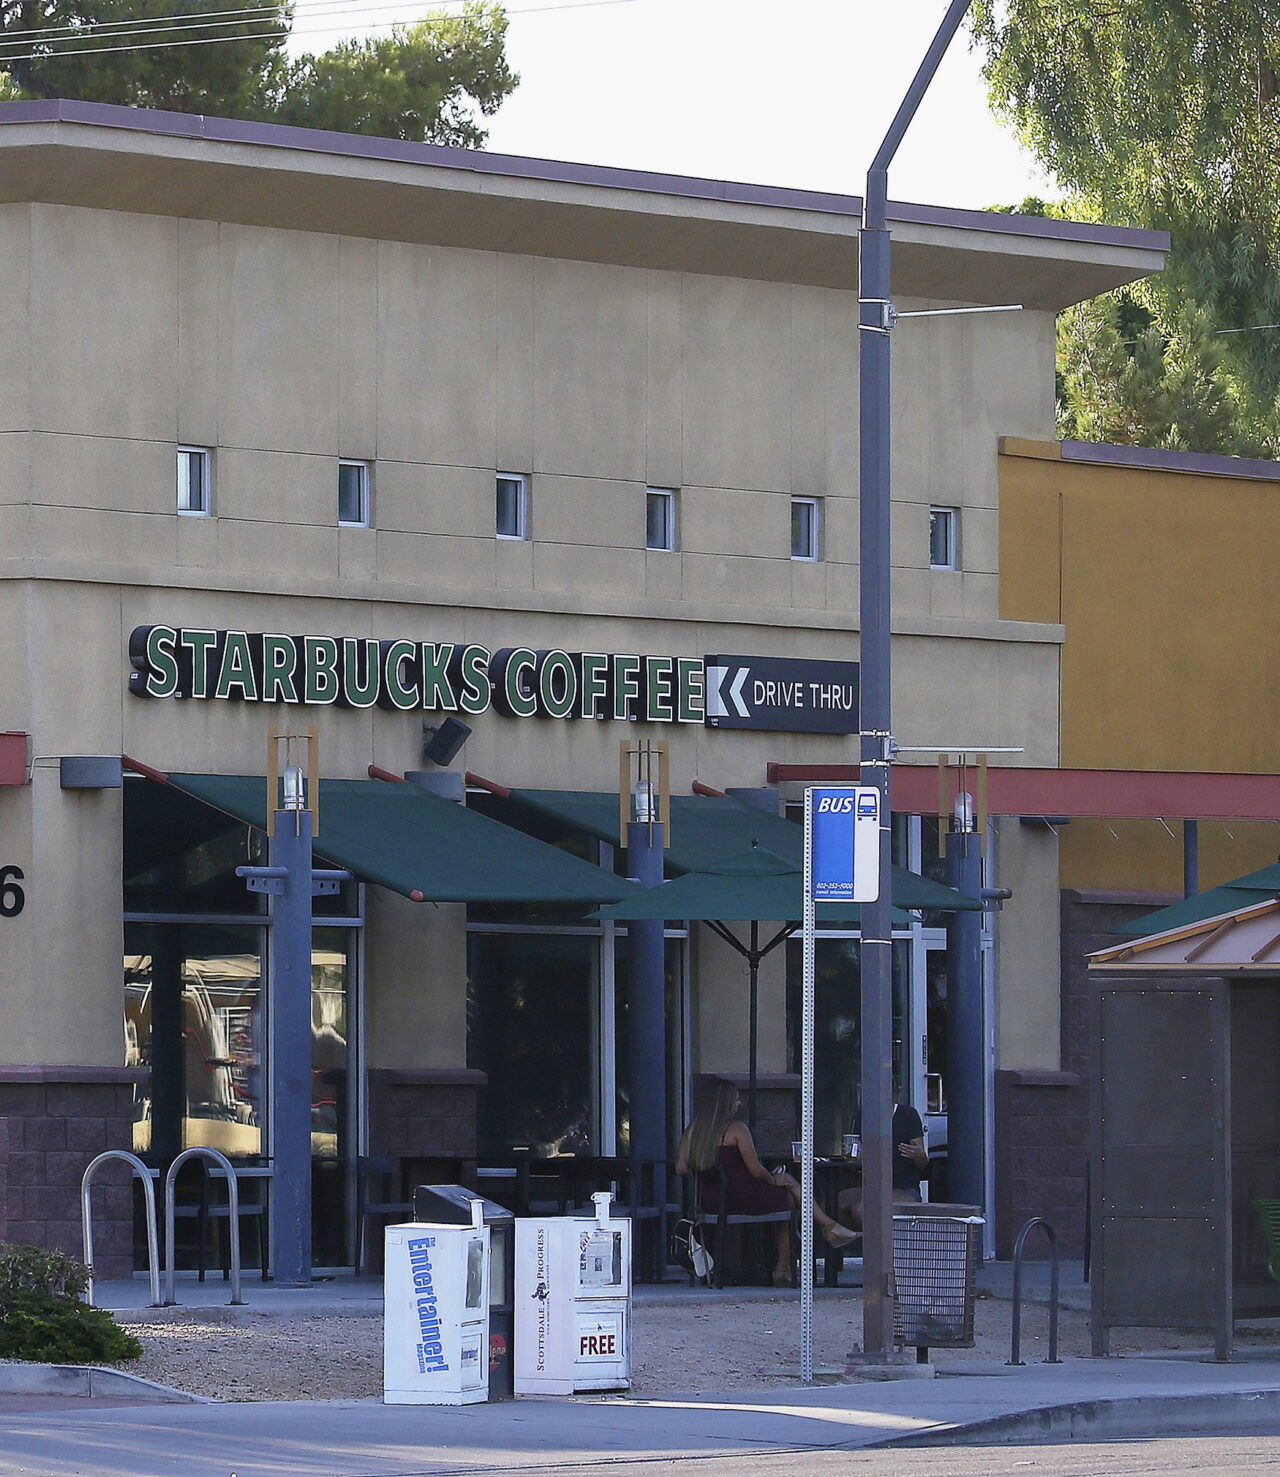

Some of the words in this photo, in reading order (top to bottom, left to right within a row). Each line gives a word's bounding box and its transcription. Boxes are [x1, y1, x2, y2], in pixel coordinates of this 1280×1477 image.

[144, 624, 492, 716] STARBUCKS
[504, 646, 706, 724] COFFEE
[753, 679, 804, 708] DRIVE
[809, 682, 854, 711] THRU
[818, 797, 854, 813] BUS
[536, 1228, 545, 1280] PROGRESS
[407, 1237, 450, 1374] Entertainer!
[536, 1307, 545, 1372] SCOTTSDALE
[580, 1334, 616, 1356] FREE
